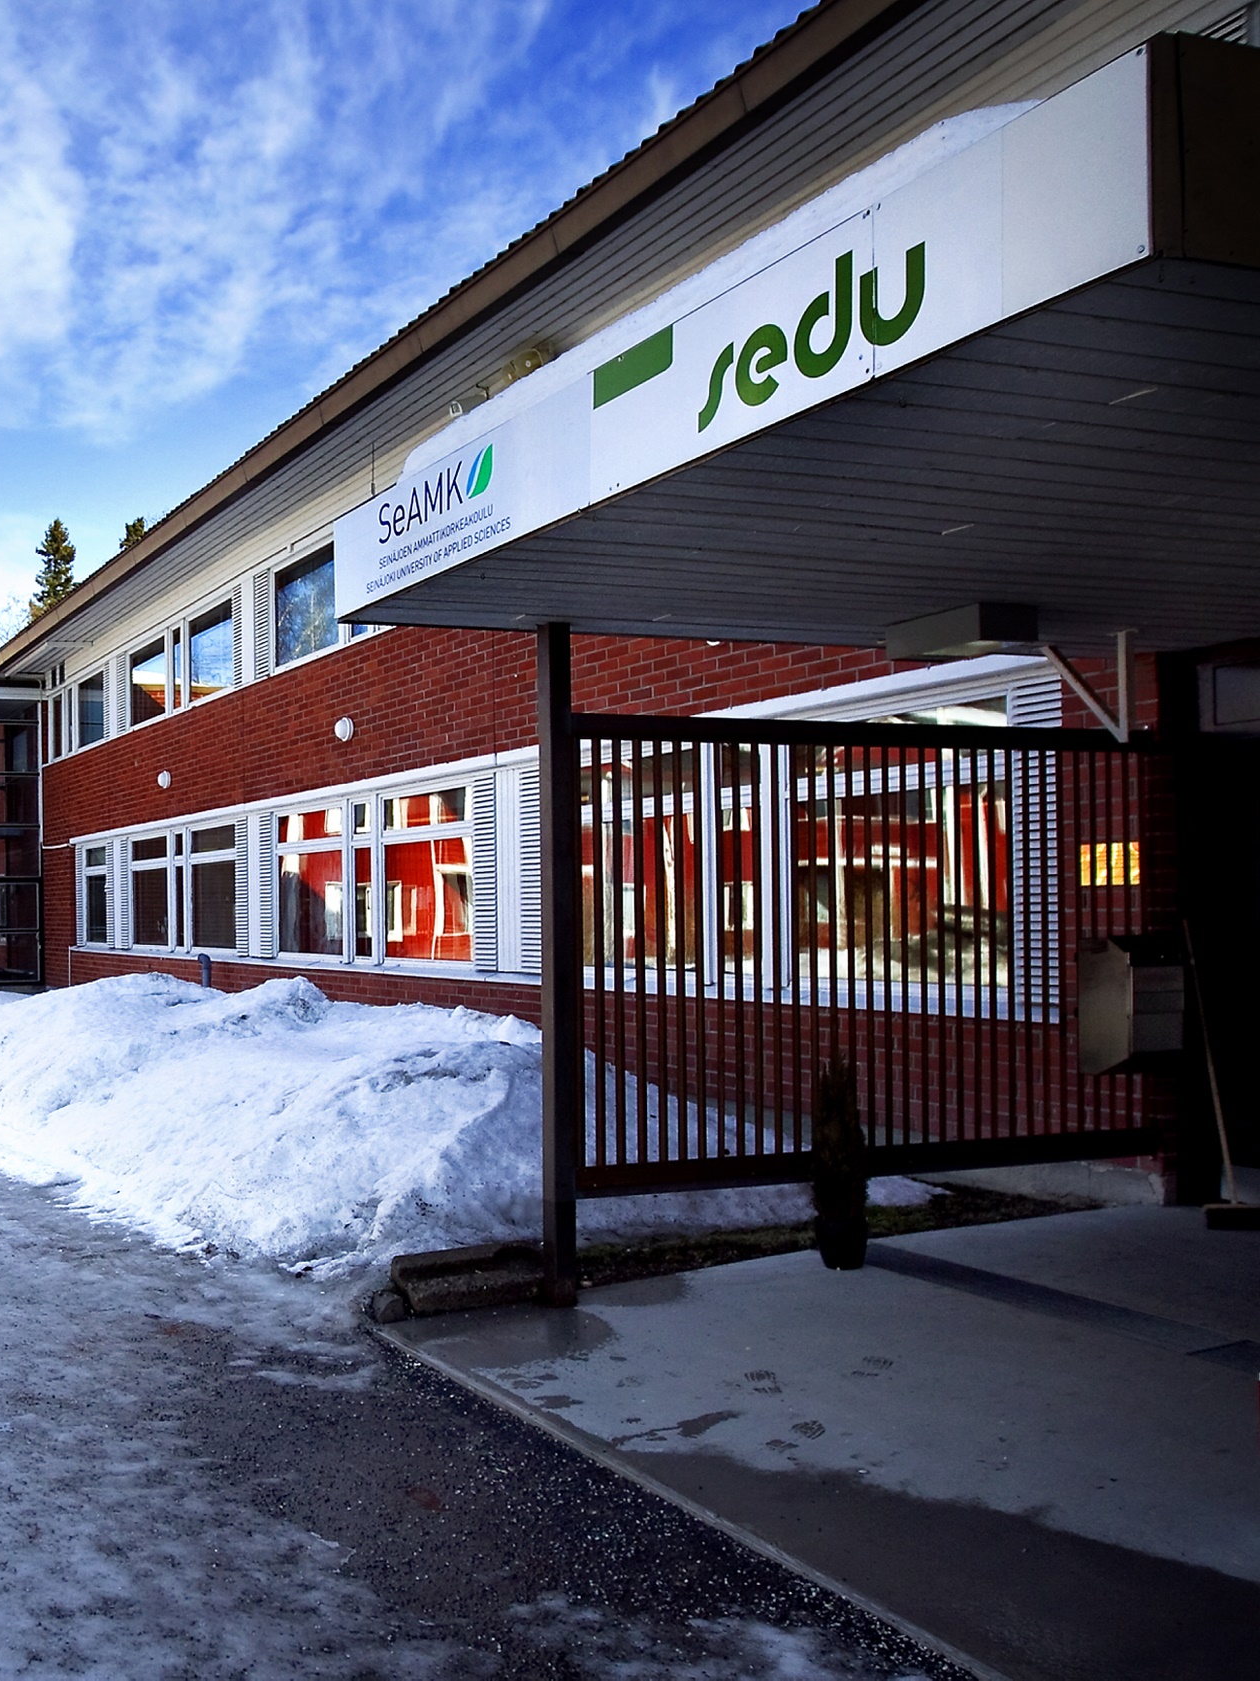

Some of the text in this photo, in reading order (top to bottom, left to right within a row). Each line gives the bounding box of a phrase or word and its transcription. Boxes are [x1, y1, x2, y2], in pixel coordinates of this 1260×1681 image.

[698, 241, 925, 433] sedu
[378, 461, 463, 544] SeAMK
[379, 504, 493, 569] SEINÄJOEN AMMATTIKORKEAKOULU
[366, 516, 511, 594] SEINÄJOKI UNIVERSITY OF APPLIED SCIENCES
